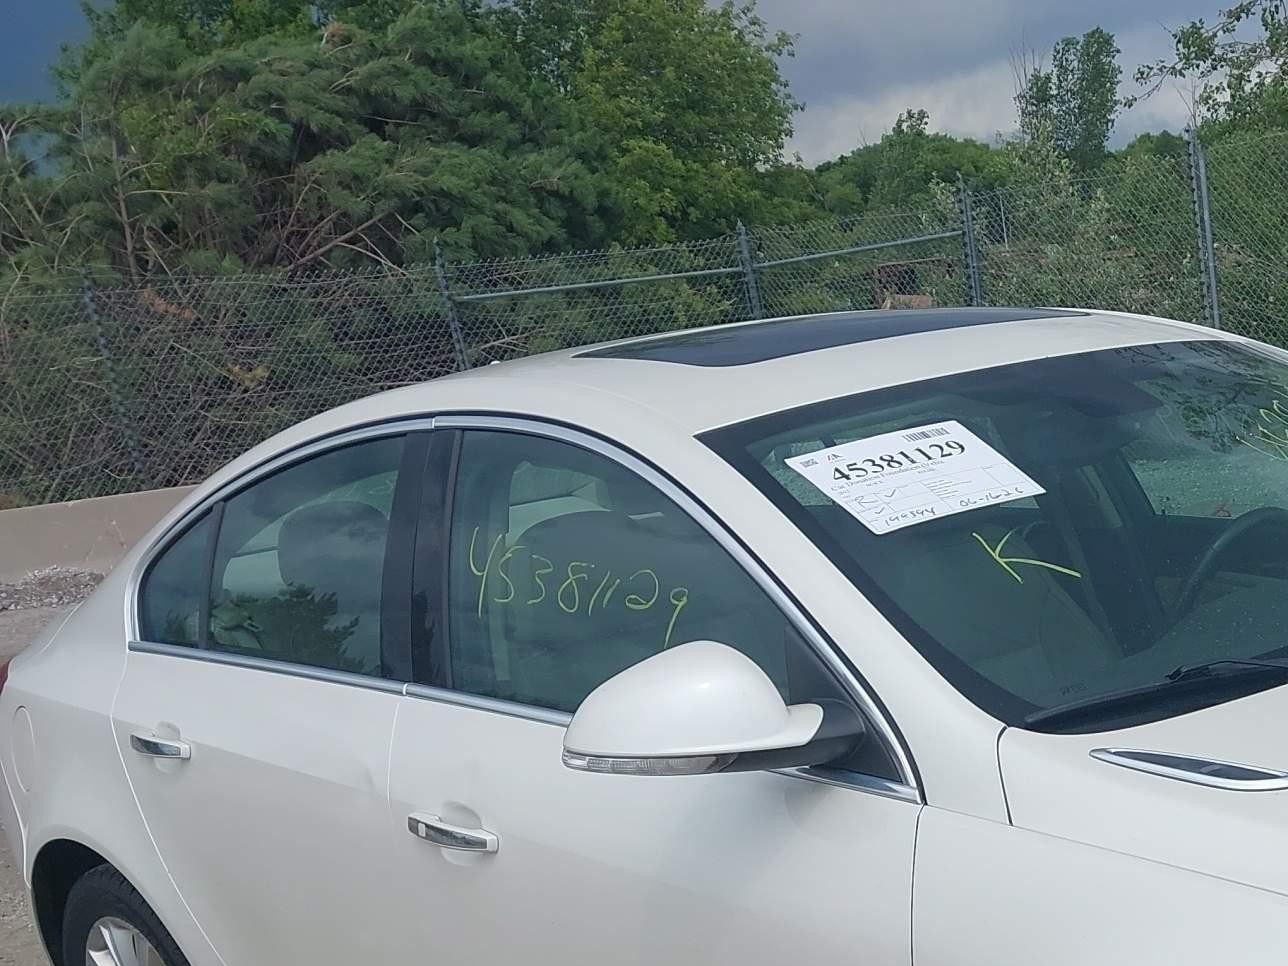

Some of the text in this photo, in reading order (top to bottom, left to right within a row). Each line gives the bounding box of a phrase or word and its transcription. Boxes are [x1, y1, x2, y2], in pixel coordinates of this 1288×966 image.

[832, 440, 966, 483] 45381129
[971, 525, 1082, 585] K
[469, 526, 689, 650] 45381129
